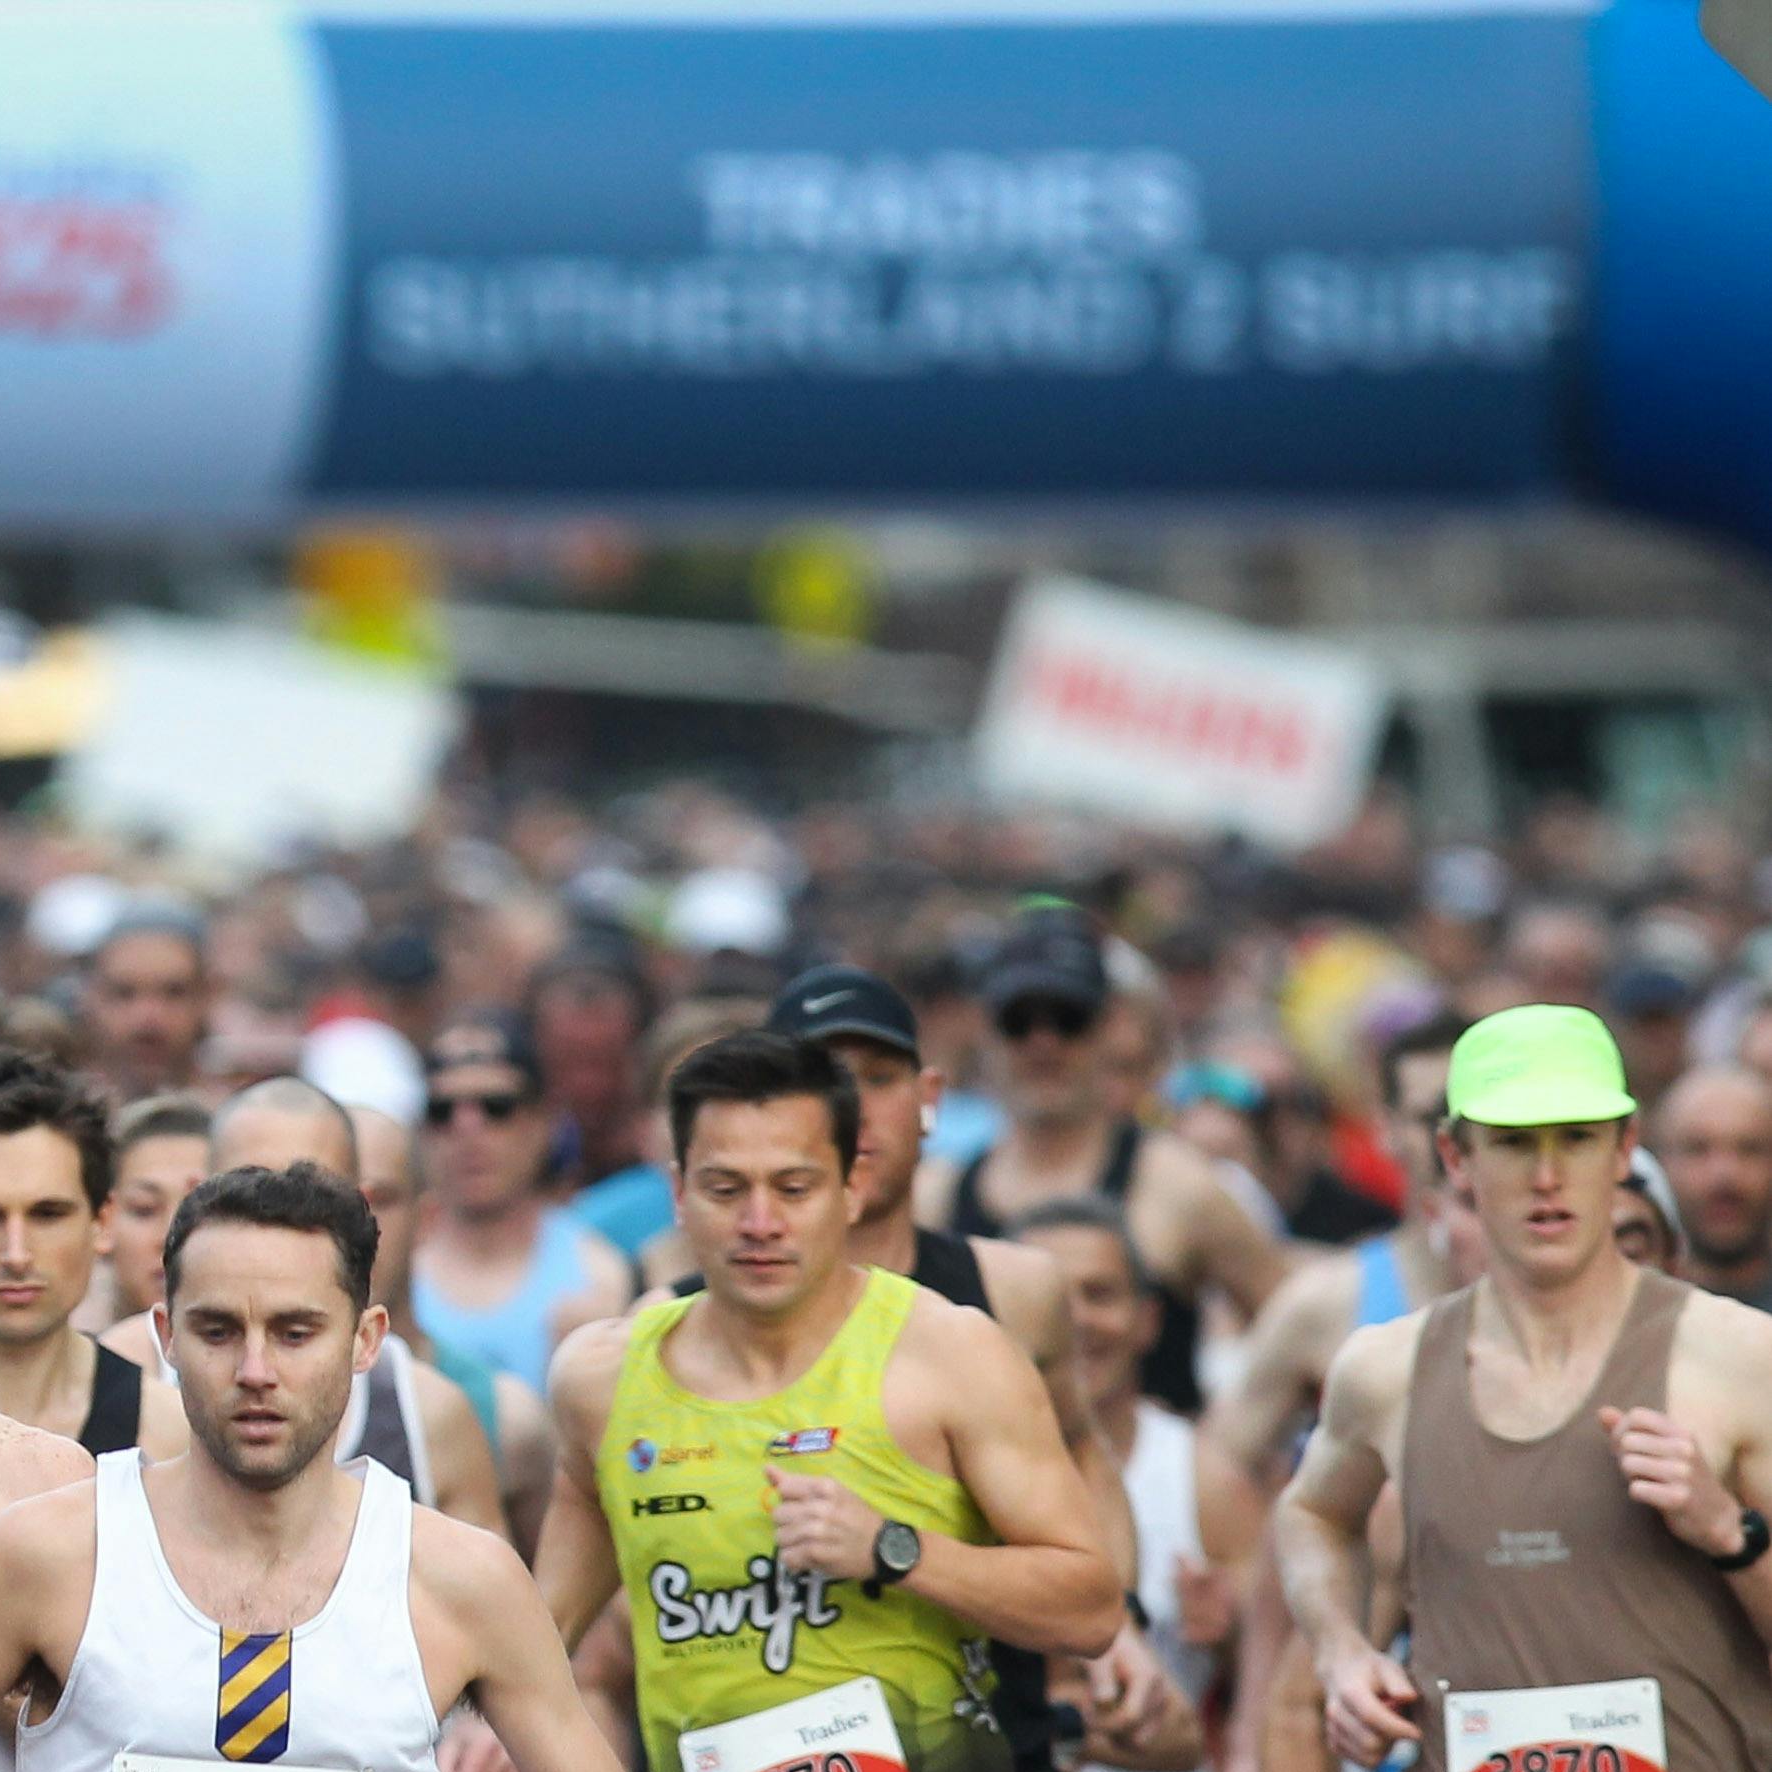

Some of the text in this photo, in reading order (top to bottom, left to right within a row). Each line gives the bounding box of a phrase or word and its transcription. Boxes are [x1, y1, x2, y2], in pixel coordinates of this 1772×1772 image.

[698, 153, 1201, 255] TRADIES
[366, 255, 1575, 377] SUTHERLAND 2 SURF
[648, 1554, 842, 1674] Swift
